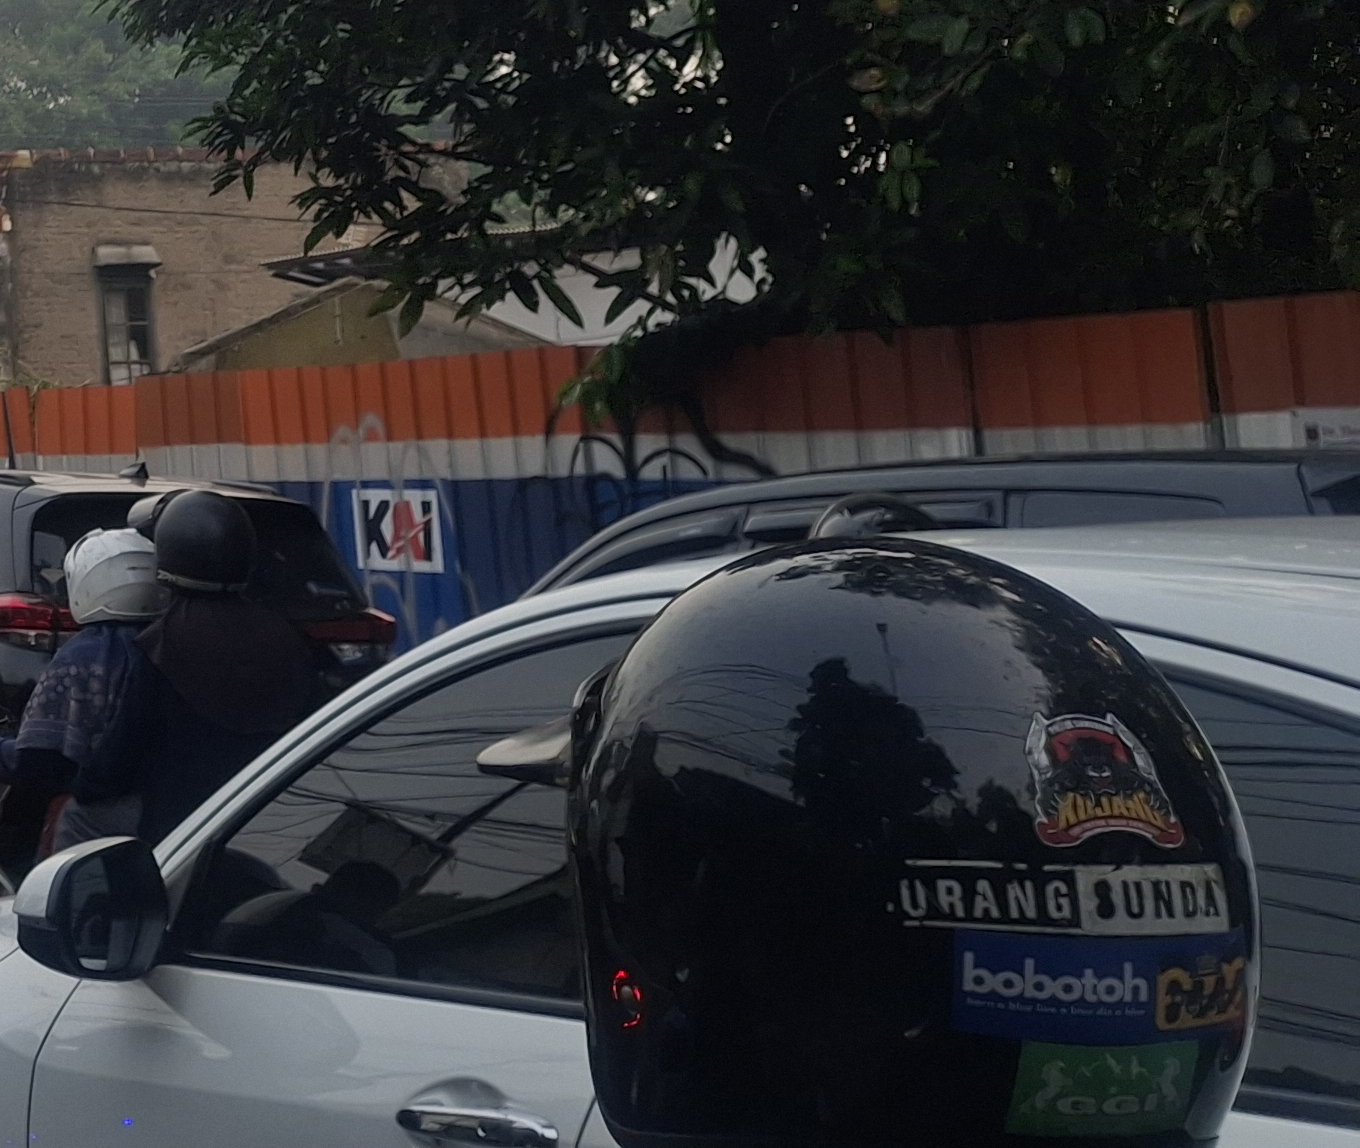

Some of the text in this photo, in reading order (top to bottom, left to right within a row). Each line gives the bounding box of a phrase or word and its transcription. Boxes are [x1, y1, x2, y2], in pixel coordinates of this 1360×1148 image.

[361, 499, 433, 563] KAI
[899, 877, 1223, 920] URANG SUNDA
[962, 950, 1149, 1003] bobotoh
